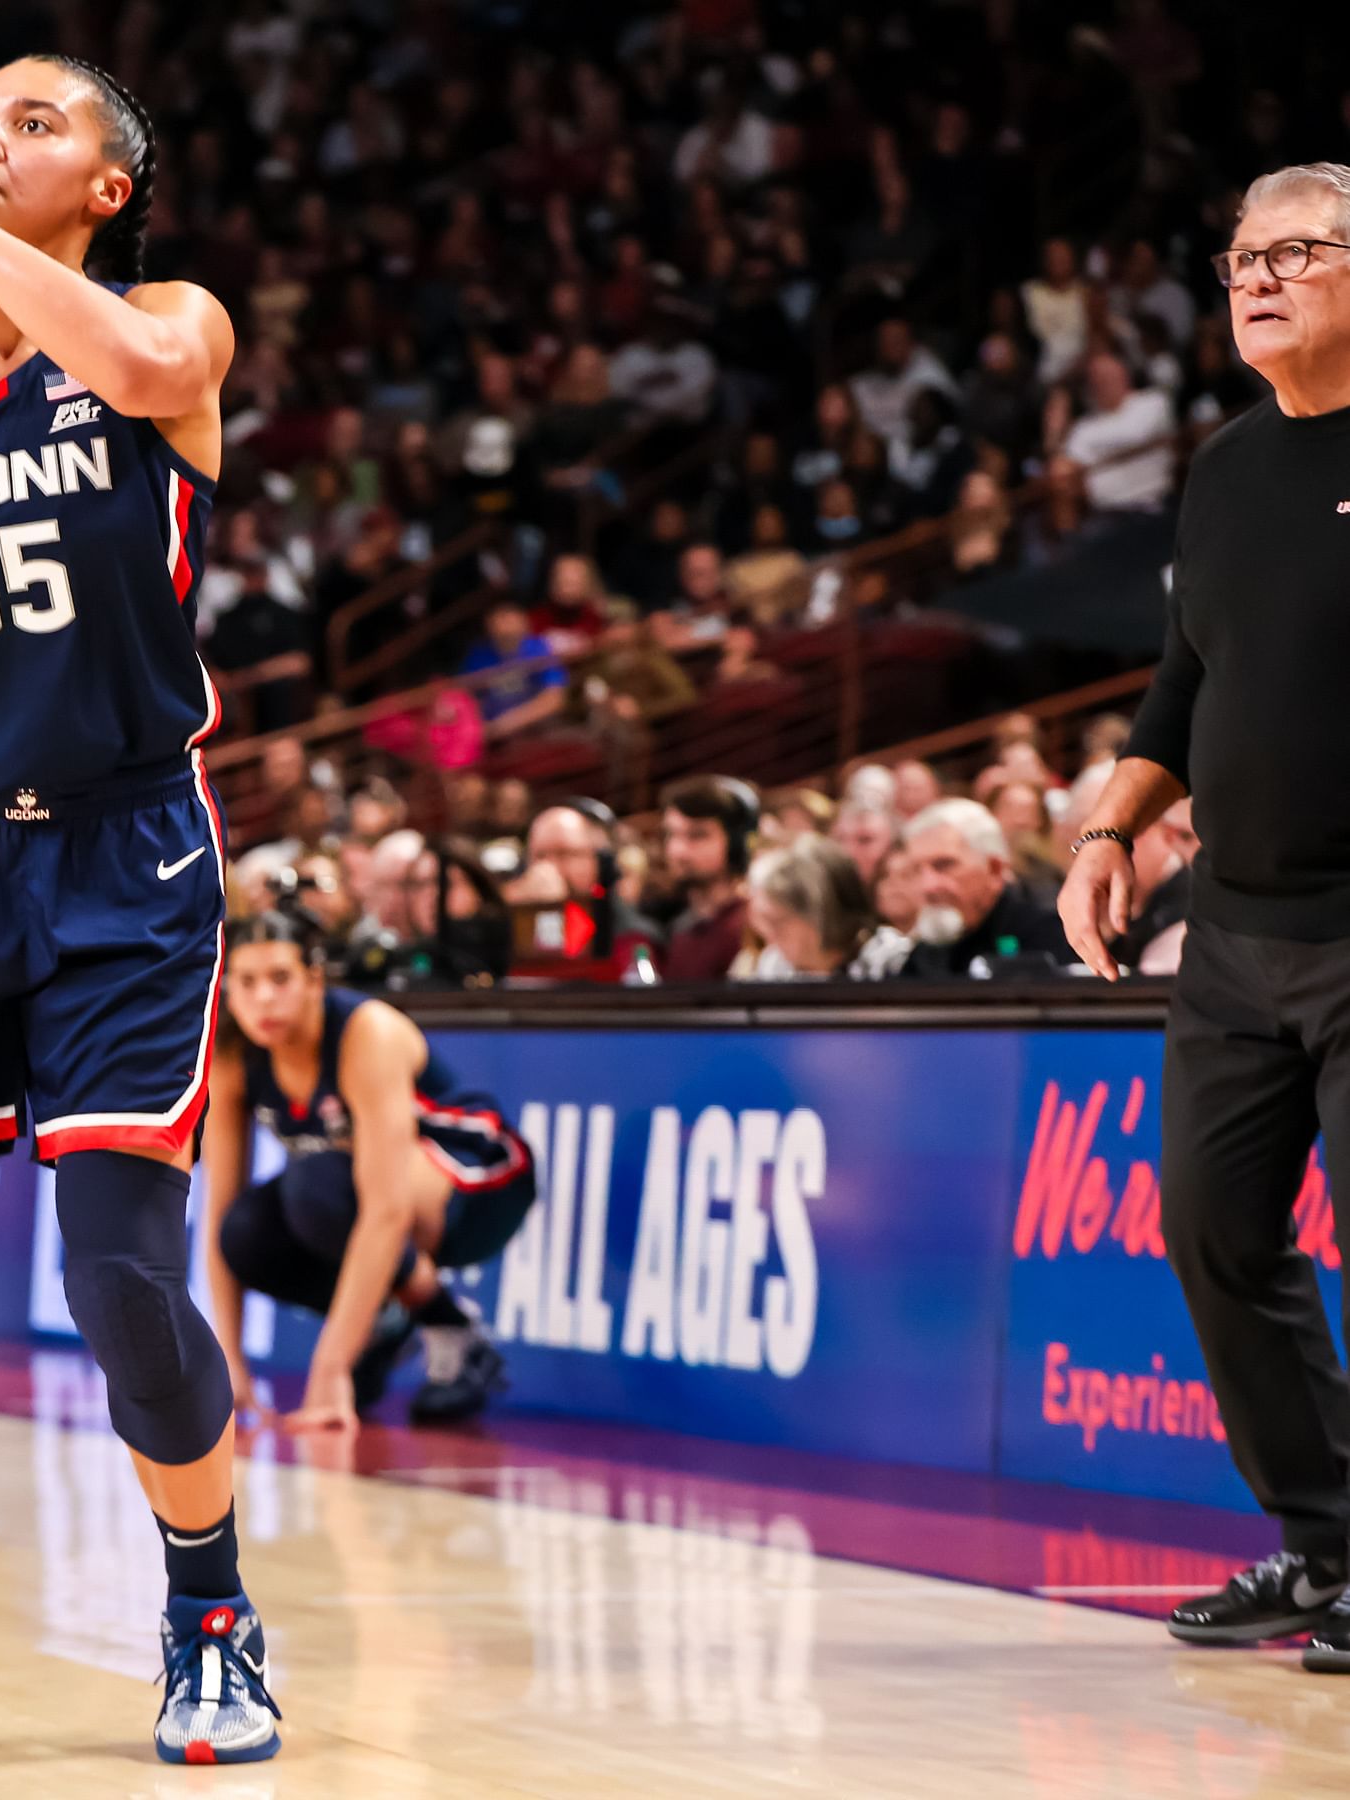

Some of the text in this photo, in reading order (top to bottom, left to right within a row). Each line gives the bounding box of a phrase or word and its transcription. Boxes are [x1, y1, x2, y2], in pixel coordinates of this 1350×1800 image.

[4, 807, 50, 821] UCONN
[495, 1102, 615, 1354] ALL
[621, 1105, 826, 1379] AGES
